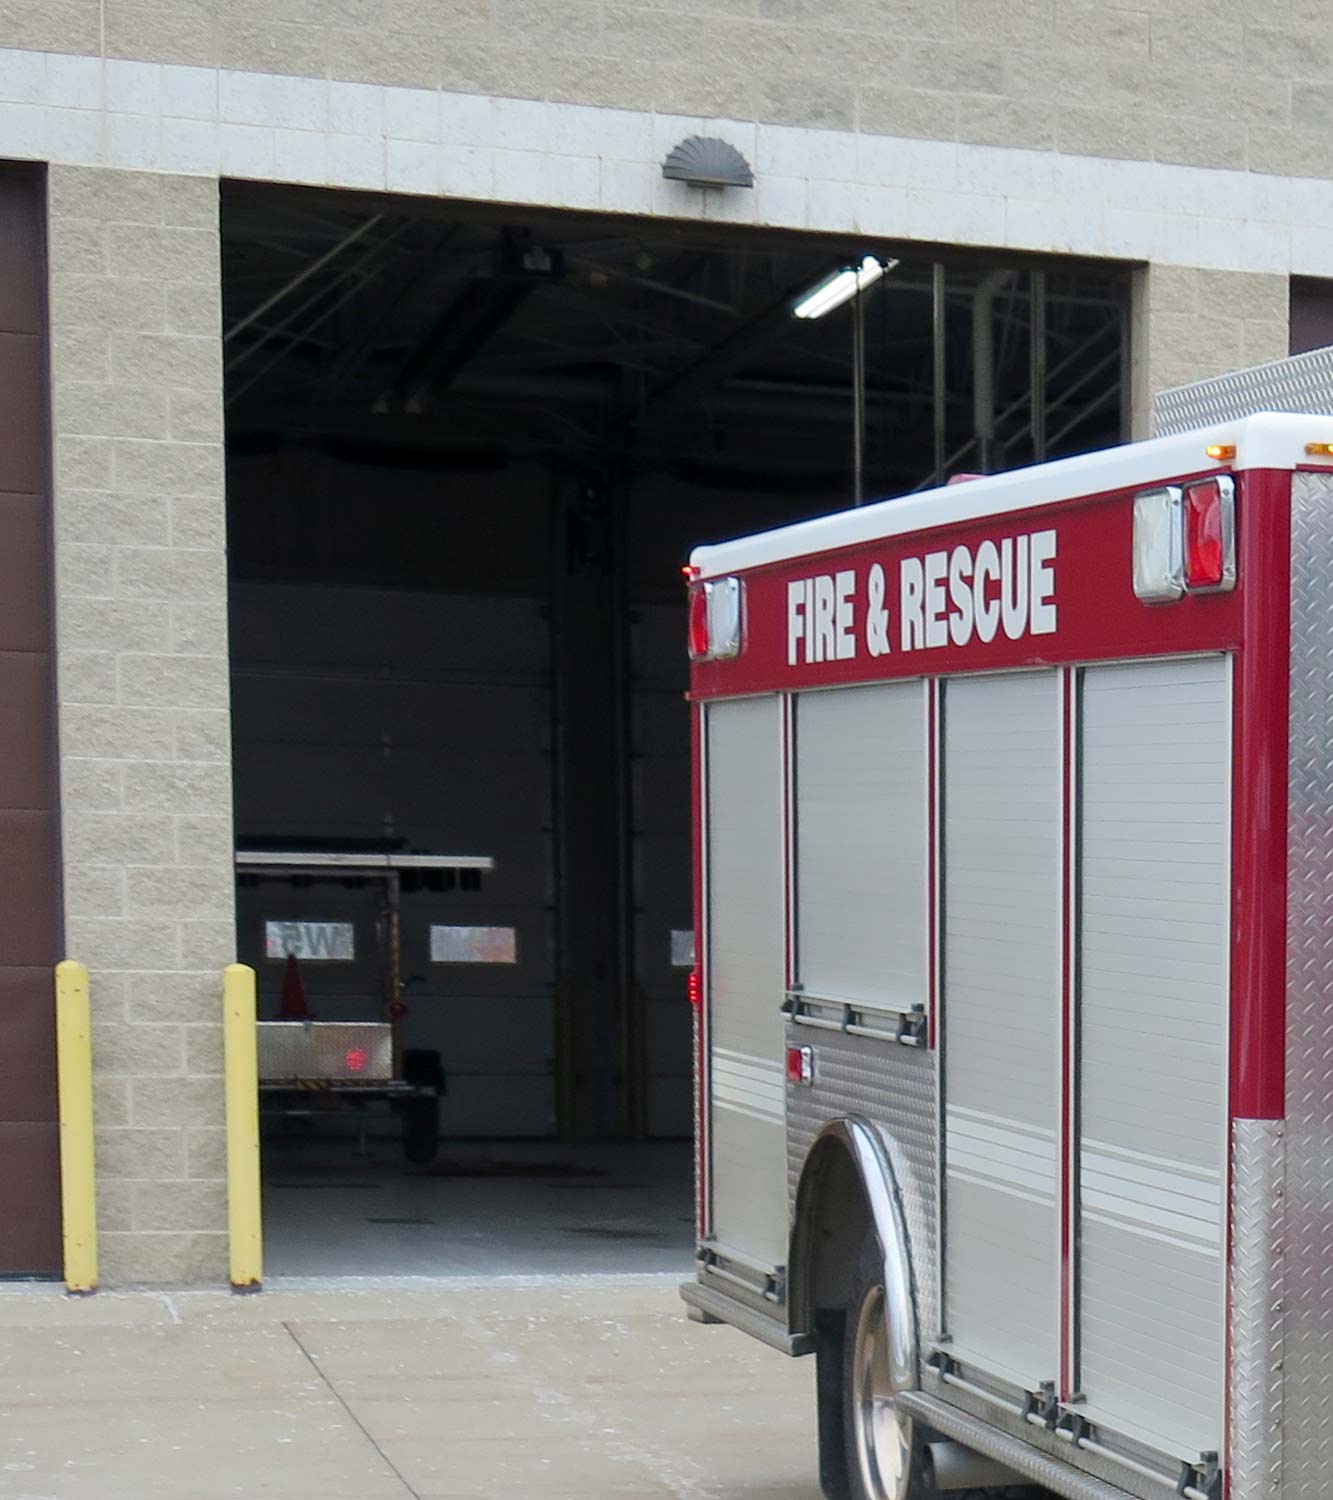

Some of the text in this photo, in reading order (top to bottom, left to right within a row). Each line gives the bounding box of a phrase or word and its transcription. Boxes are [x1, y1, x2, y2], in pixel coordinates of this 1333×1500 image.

[787, 529, 1057, 666] FIRE & RESCUE
